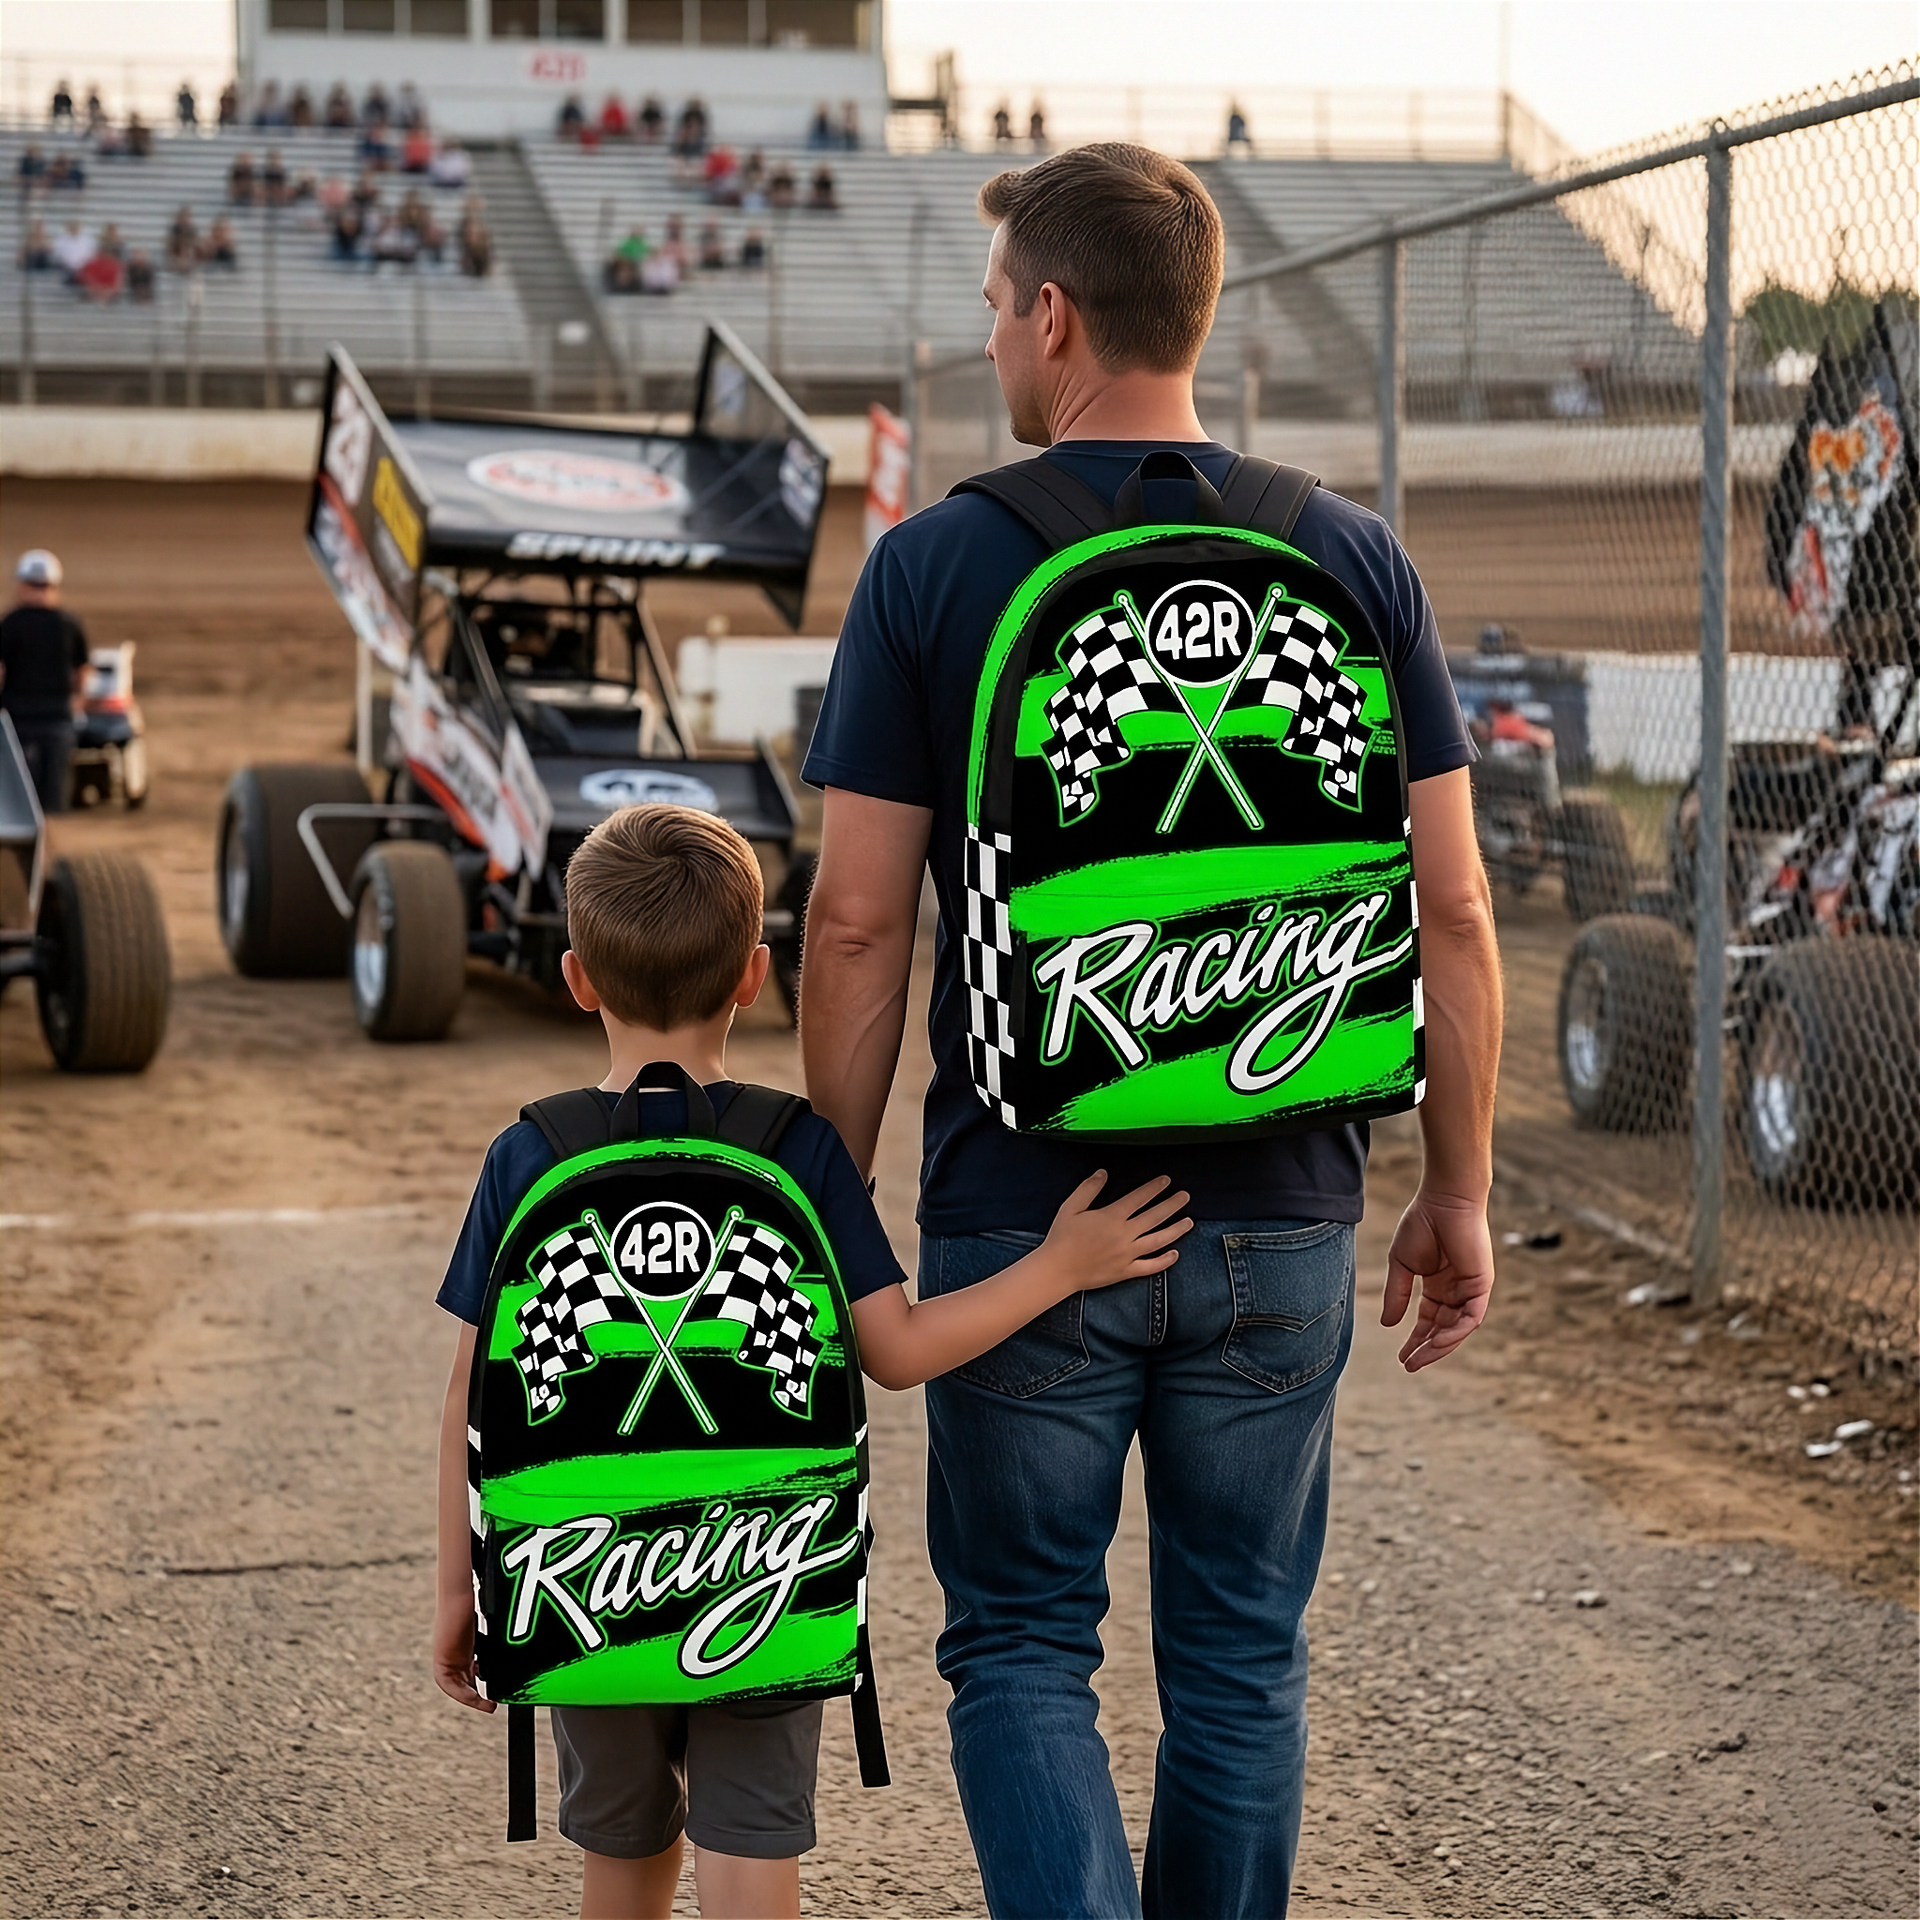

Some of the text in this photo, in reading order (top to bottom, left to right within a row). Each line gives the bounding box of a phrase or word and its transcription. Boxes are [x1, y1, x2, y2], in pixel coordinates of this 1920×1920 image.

[506, 532, 726, 569] SPRINT
[1155, 600, 1242, 660] 42R
[1036, 894, 1413, 1092] Racing
[620, 1221, 701, 1275] 42R
[504, 1497, 858, 1675] Racing
